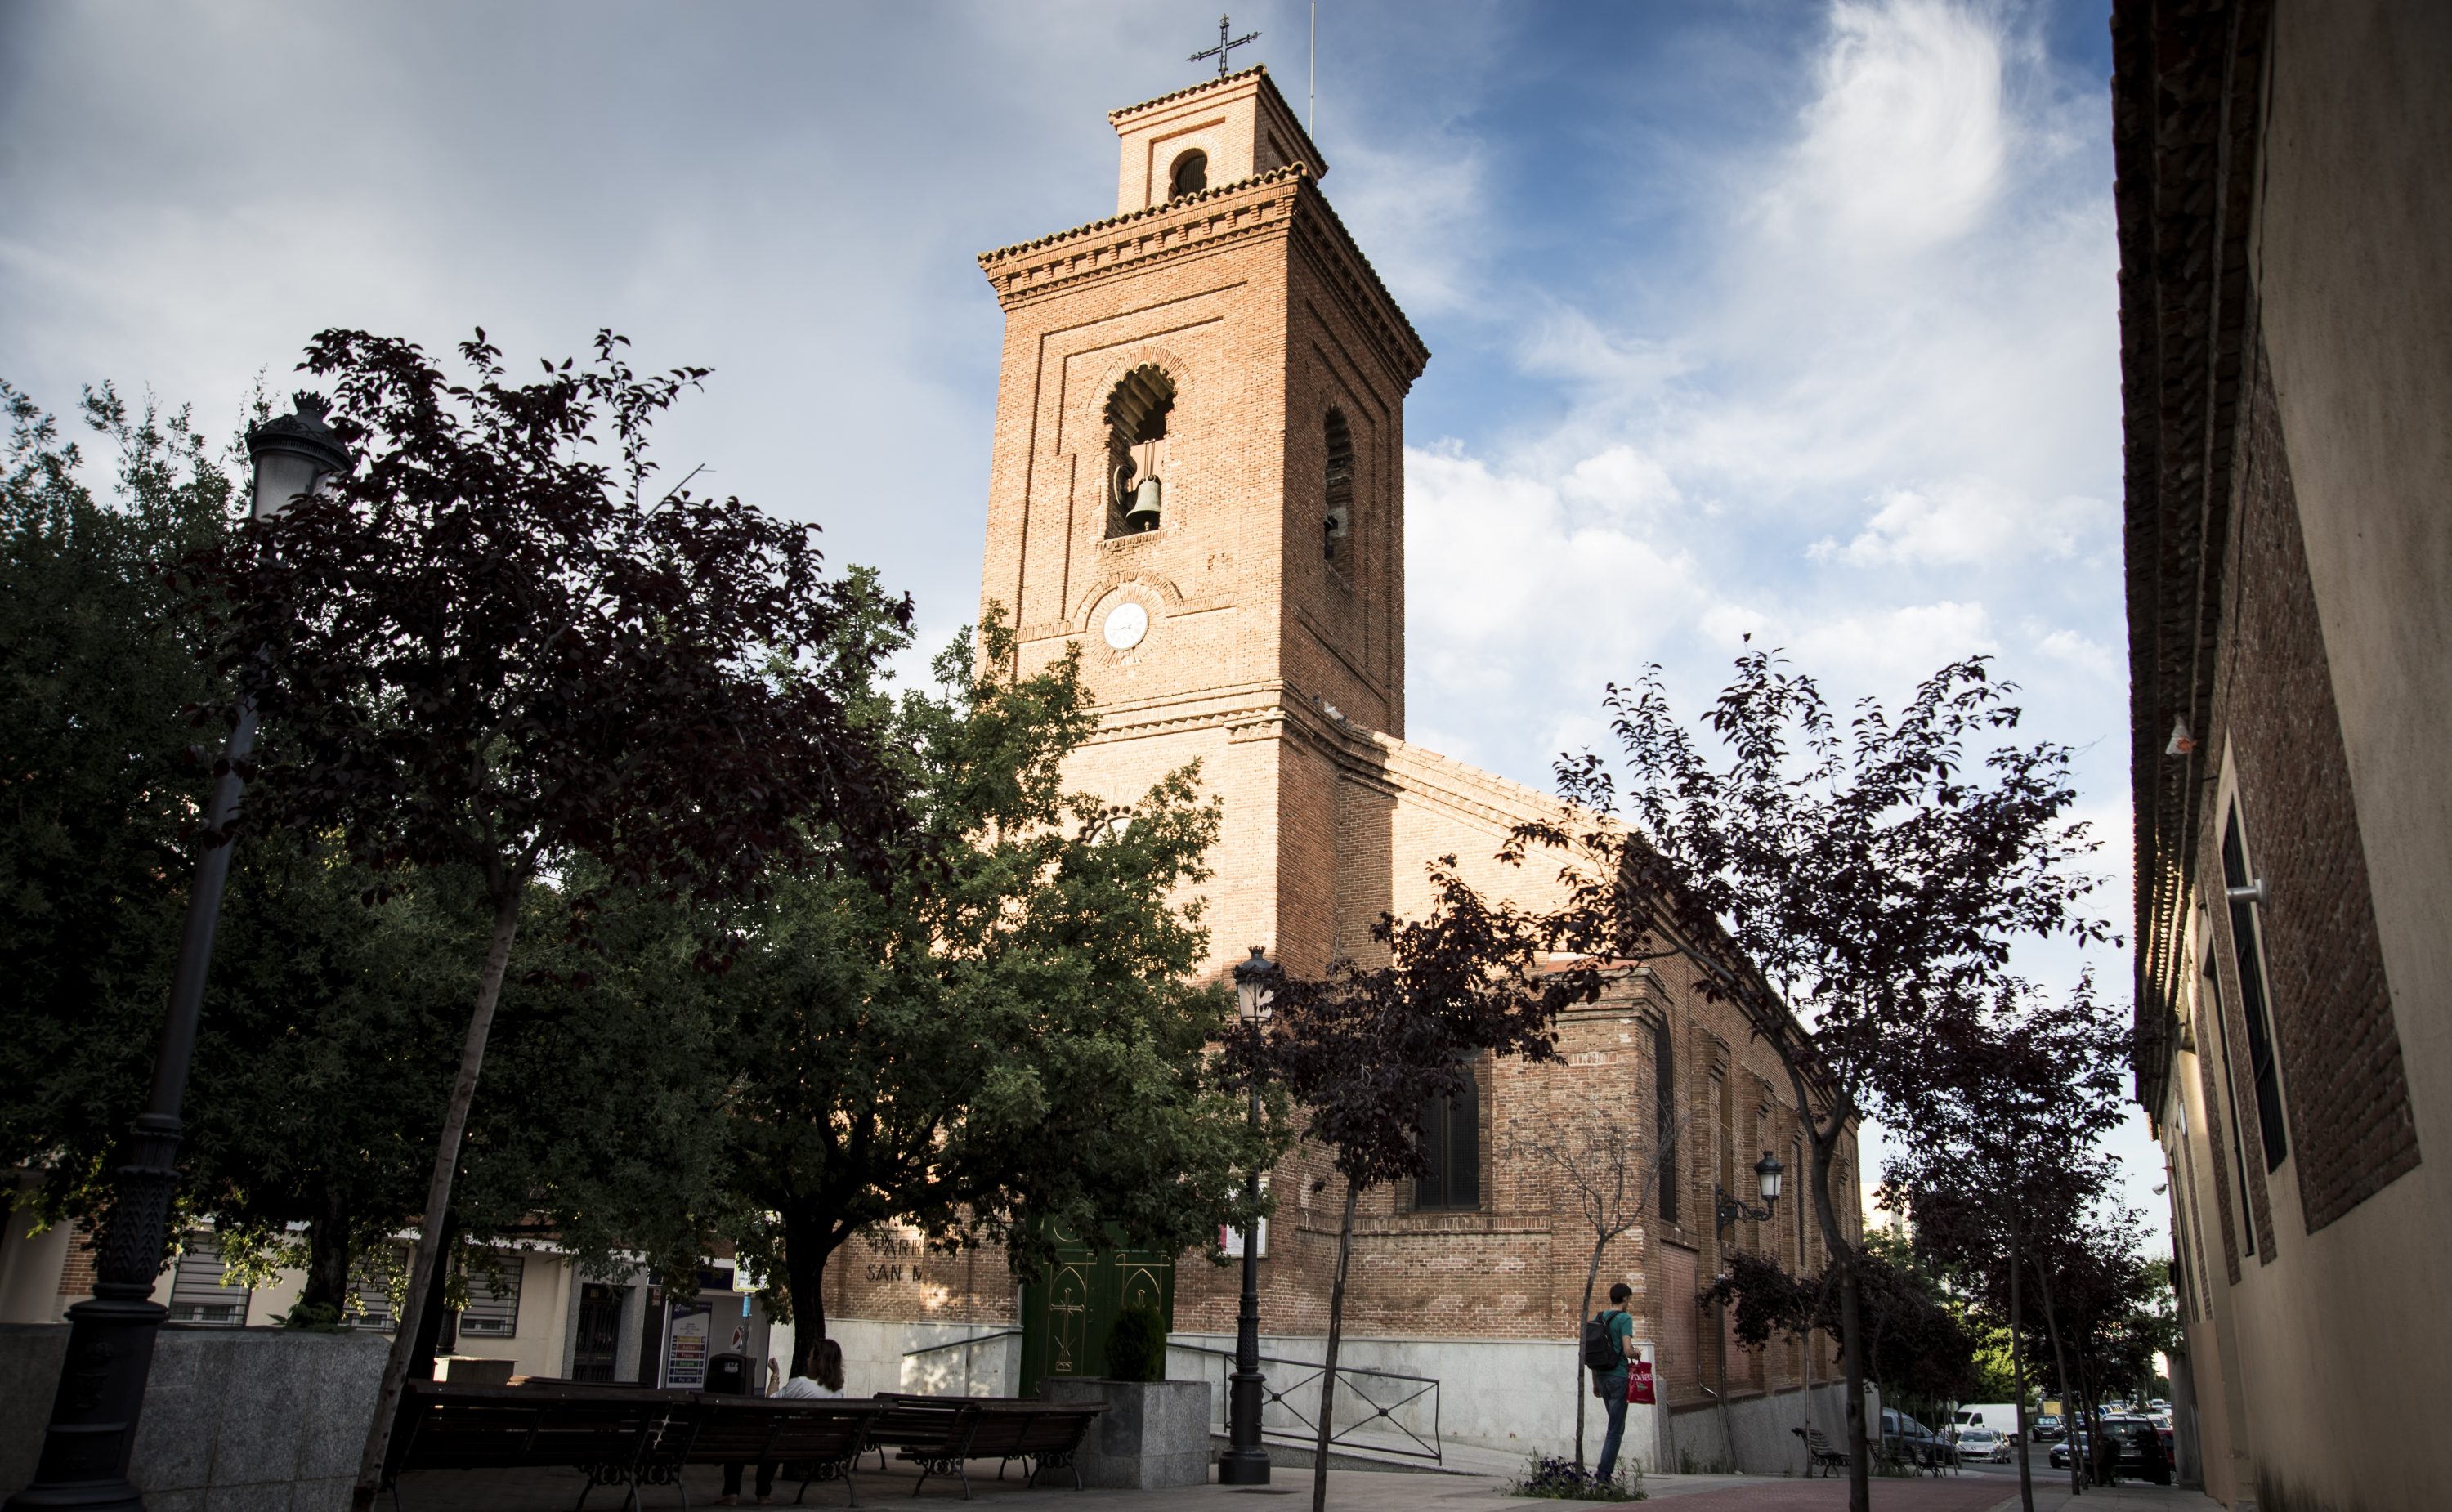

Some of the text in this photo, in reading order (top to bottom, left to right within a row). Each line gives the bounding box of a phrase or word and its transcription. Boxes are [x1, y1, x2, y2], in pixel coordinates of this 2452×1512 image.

[875, 1239, 921, 1256] PARR
[866, 1264, 923, 1282] SAN M
